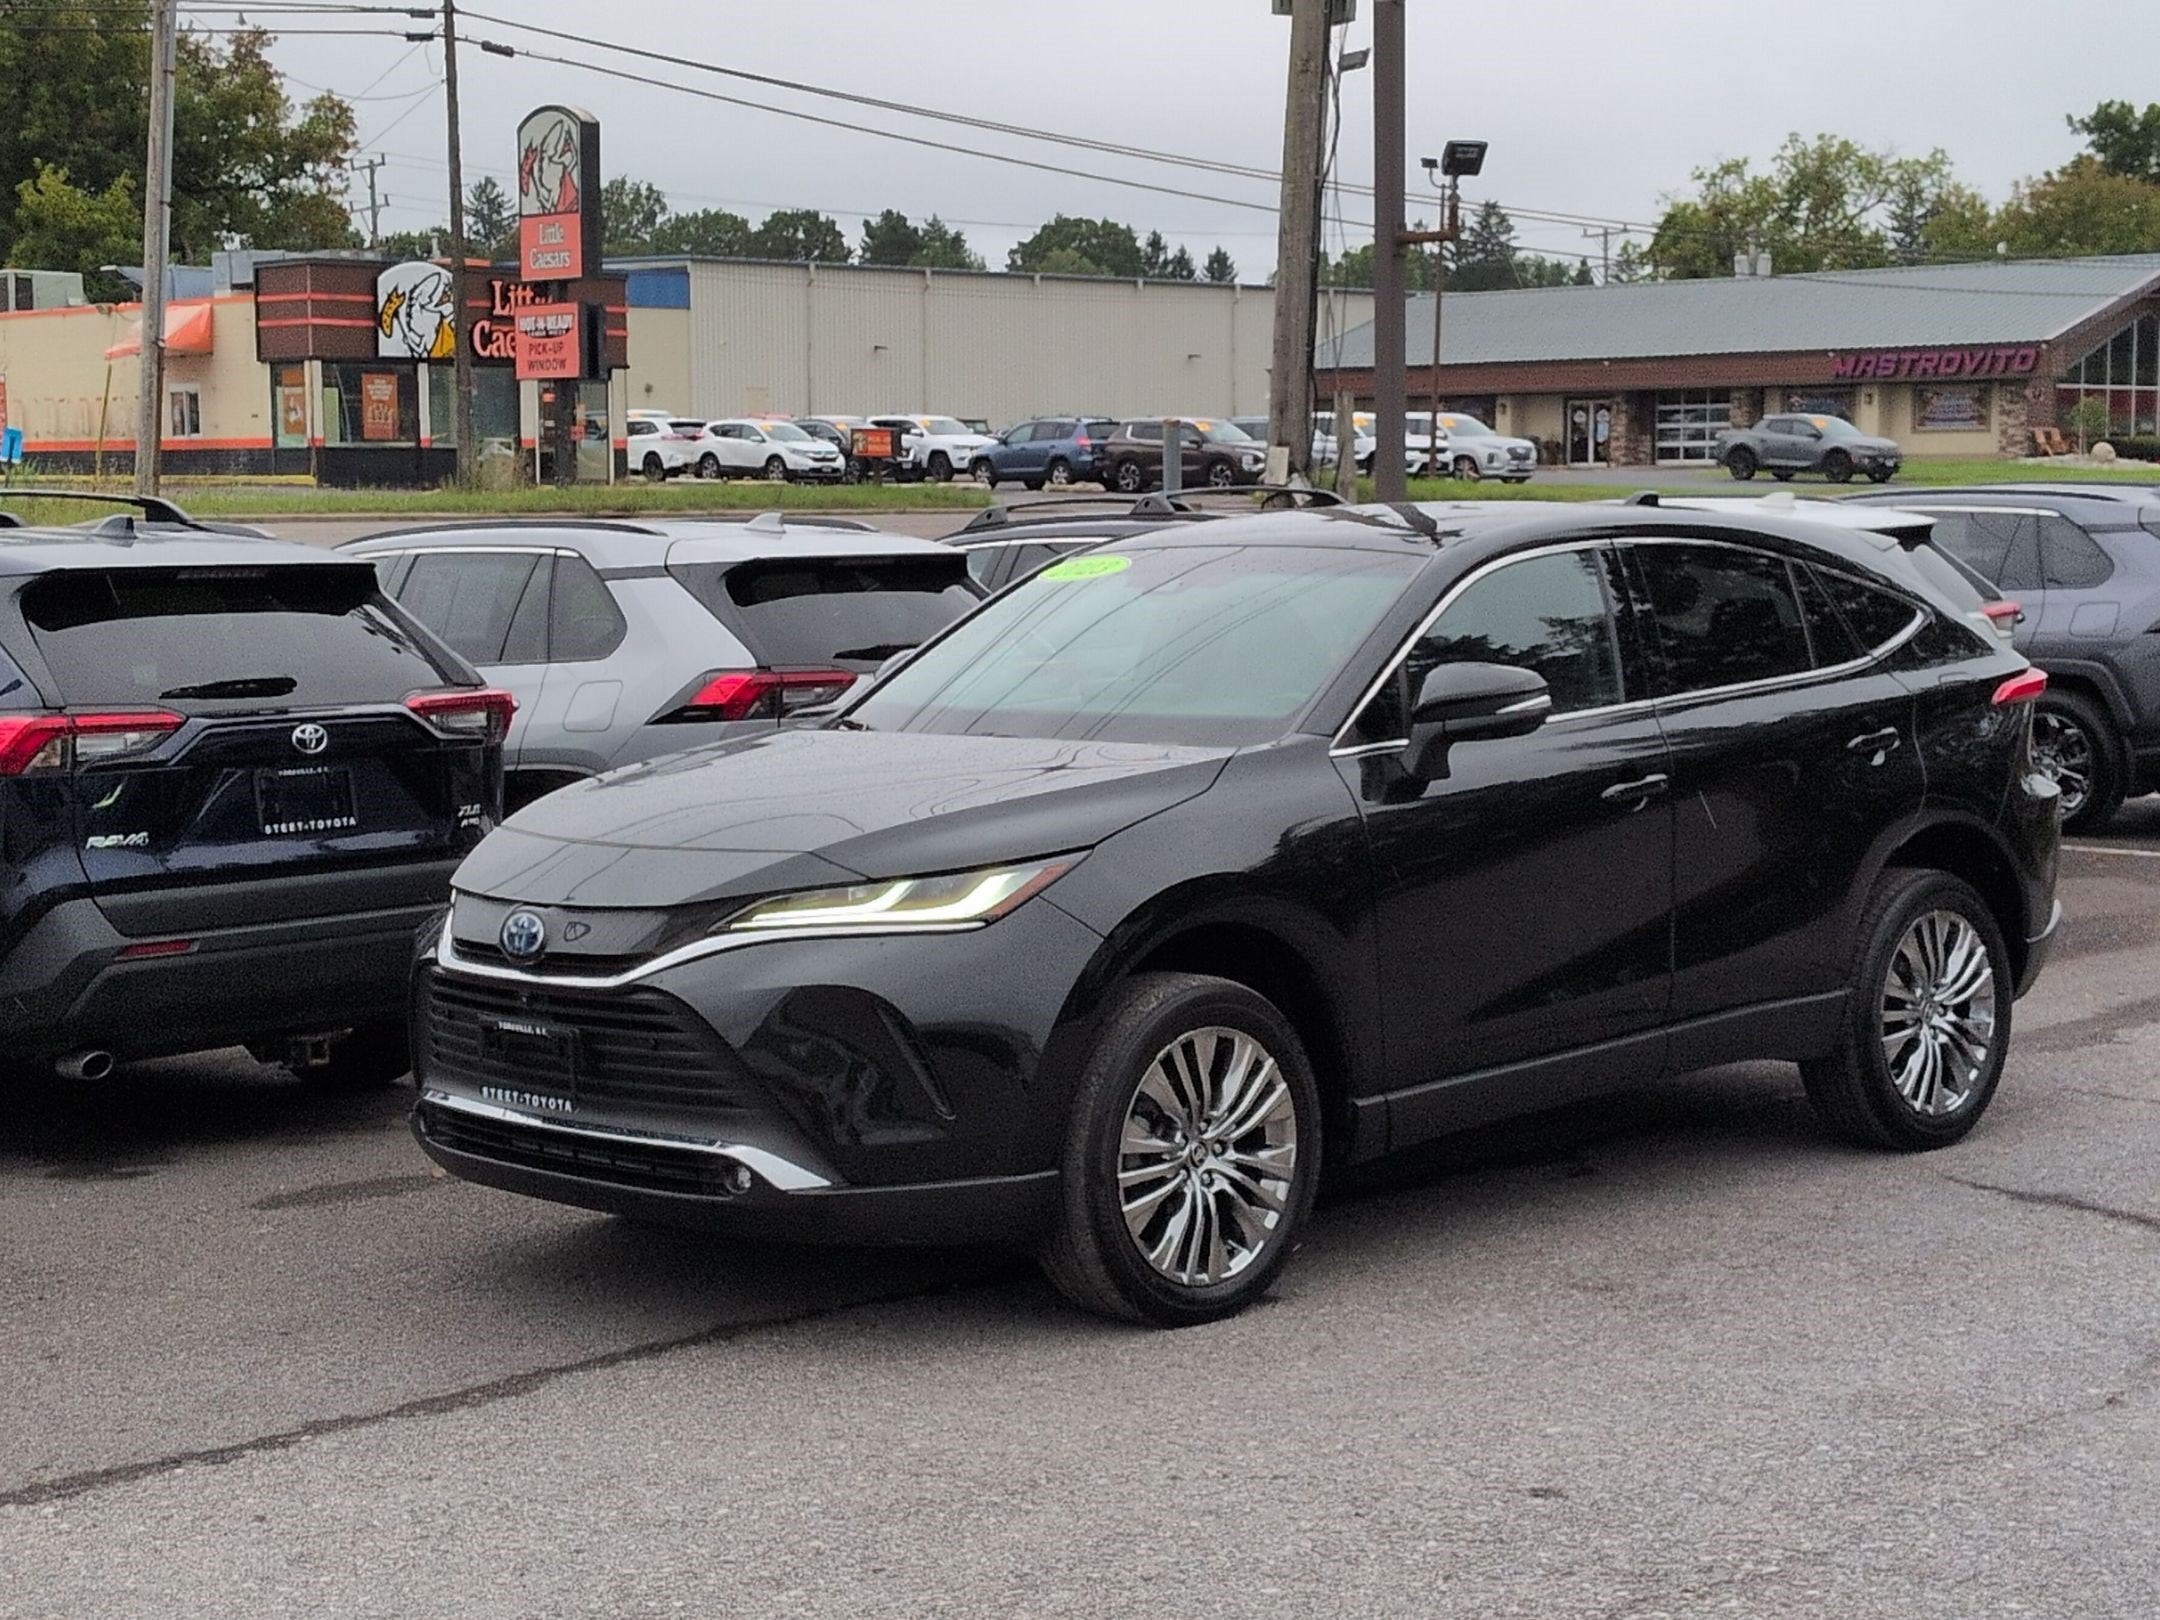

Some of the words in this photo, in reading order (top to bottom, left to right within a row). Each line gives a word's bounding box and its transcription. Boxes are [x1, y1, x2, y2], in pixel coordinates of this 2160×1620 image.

[539, 222, 564, 245] Little
[529, 248, 570, 270] Caesars
[528, 341, 564, 356] PICK-UP
[527, 358, 567, 372] WINDOW
[1832, 349, 2037, 378] MASTROVITO
[85, 831, 148, 850] RAV4
